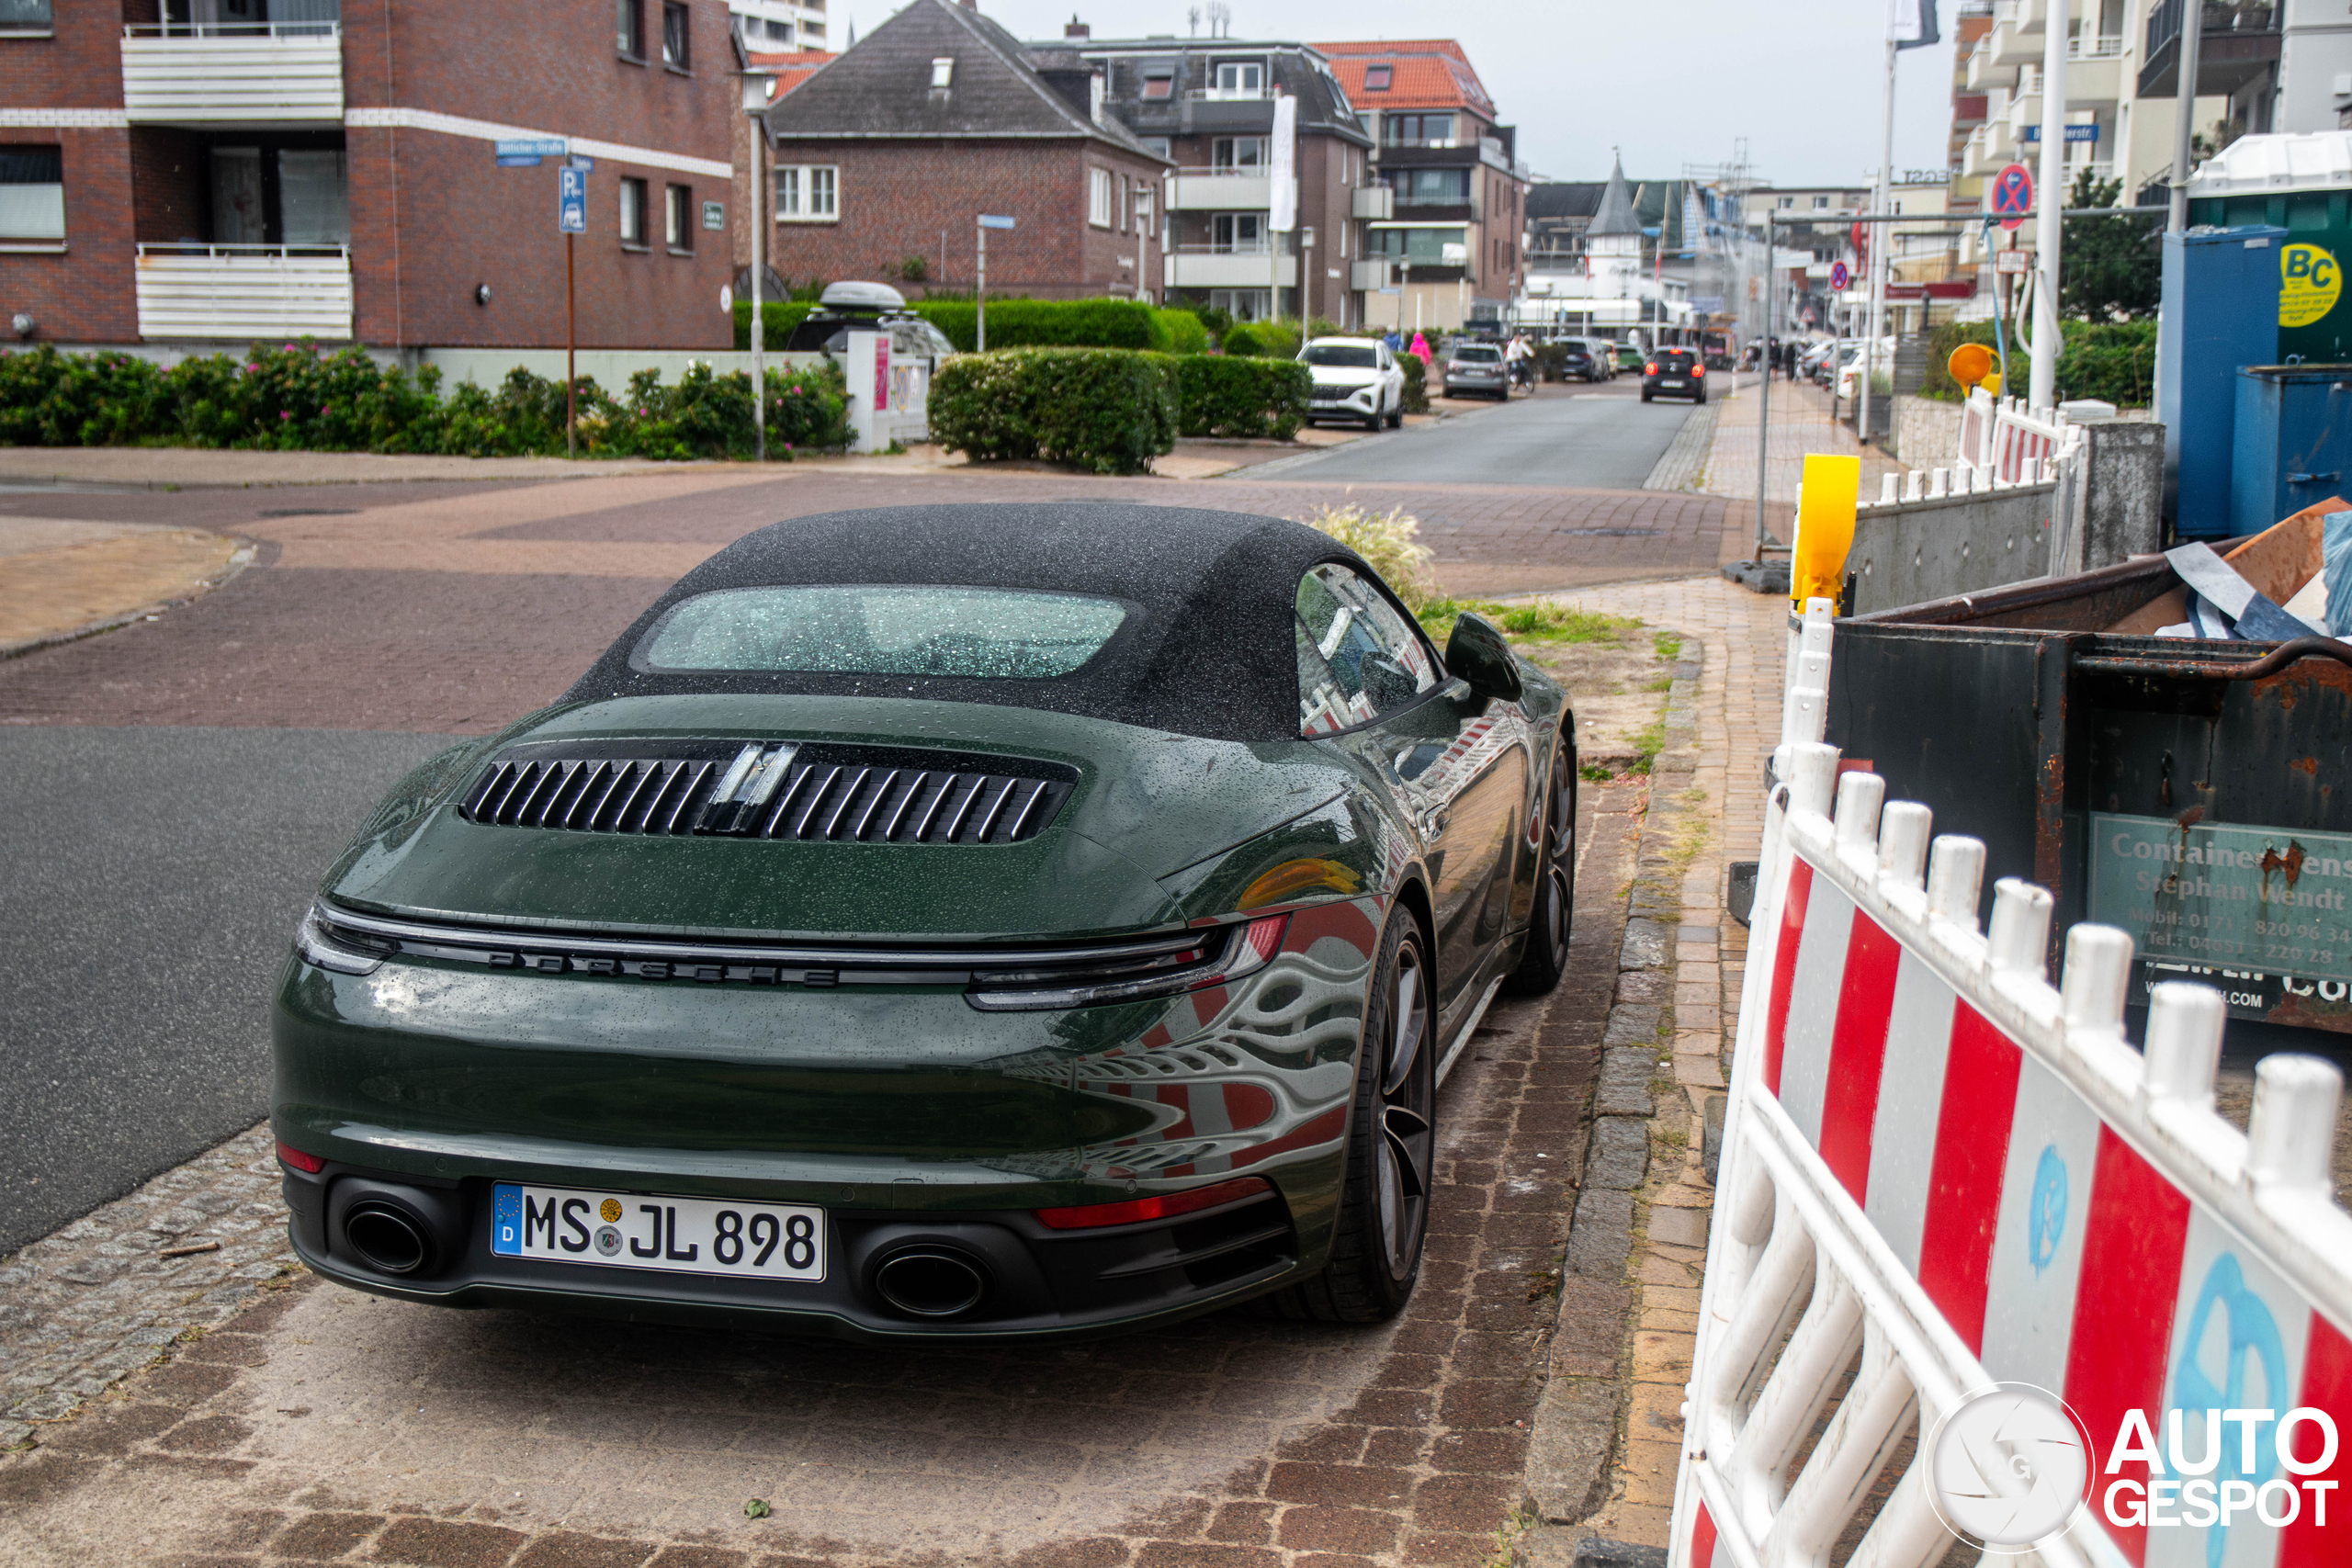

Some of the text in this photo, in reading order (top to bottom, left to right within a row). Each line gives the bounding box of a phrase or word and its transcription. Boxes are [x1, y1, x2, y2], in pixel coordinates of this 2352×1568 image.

[564, 171, 577, 198] P
[2279, 249, 2334, 288] BC
[2136, 871, 2345, 910] Stephan Wendt
[2129, 908, 2351, 943] Mobil: 0171 820 96 34
[2150, 931, 2183, 947] Tel.:
[2267, 943, 2302, 960] 220
[2309, 948, 2333, 964] 28
[489, 952, 838, 987] PORSCHE
[503, 1194, 816, 1269] D MS JL 898
